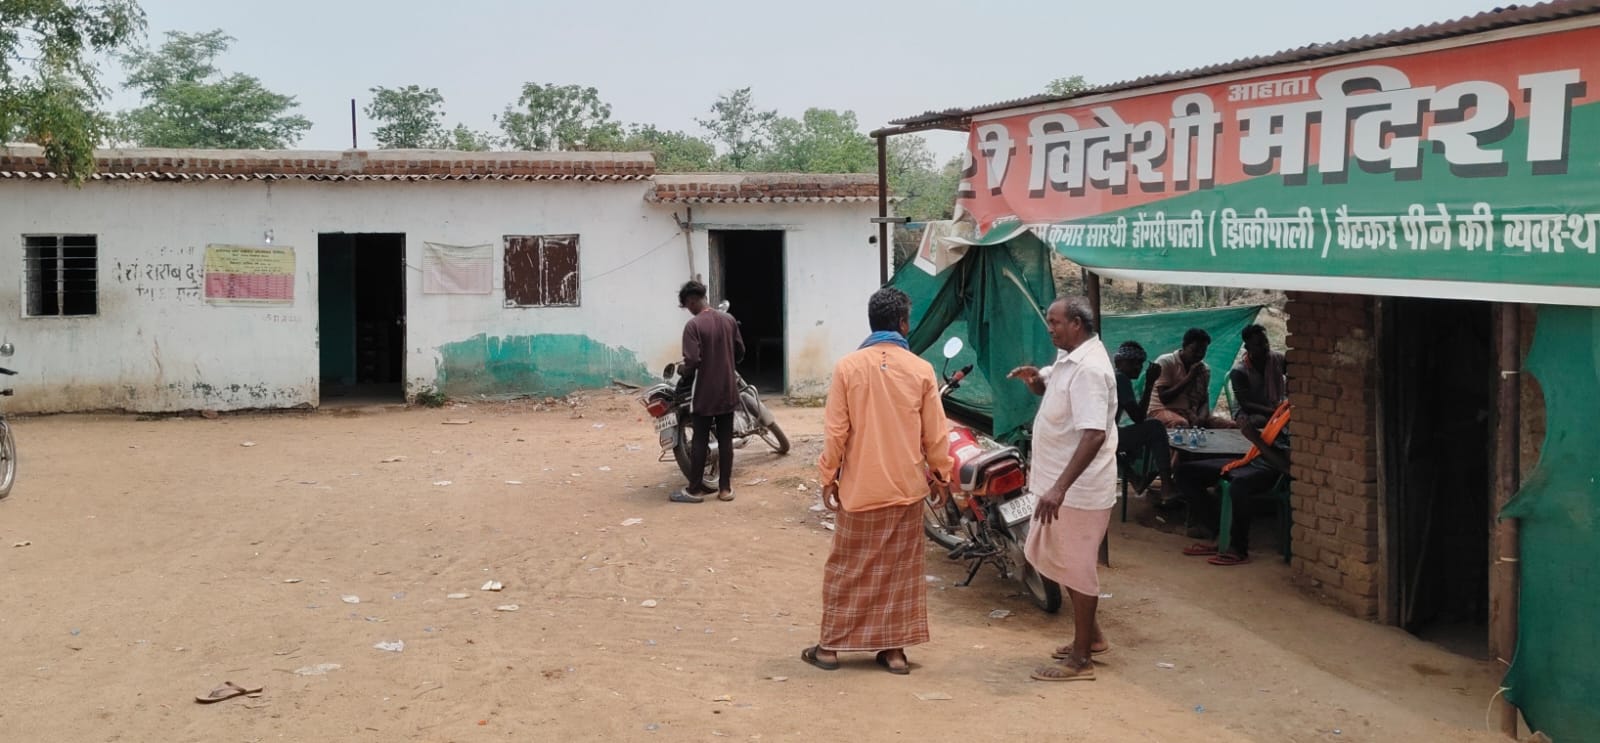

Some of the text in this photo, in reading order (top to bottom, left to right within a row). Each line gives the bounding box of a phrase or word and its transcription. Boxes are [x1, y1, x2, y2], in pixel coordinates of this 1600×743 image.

[1228, 76, 1312, 102] आहाता
[1028, 93, 1222, 193] विदेशी
[1048, 224, 1086, 249] कुमार
[1086, 215, 1128, 248] सारथी
[1399, 203, 1452, 250] पीने
[1456, 202, 1494, 251] की
[1501, 213, 1600, 253] व्यवस्थ
